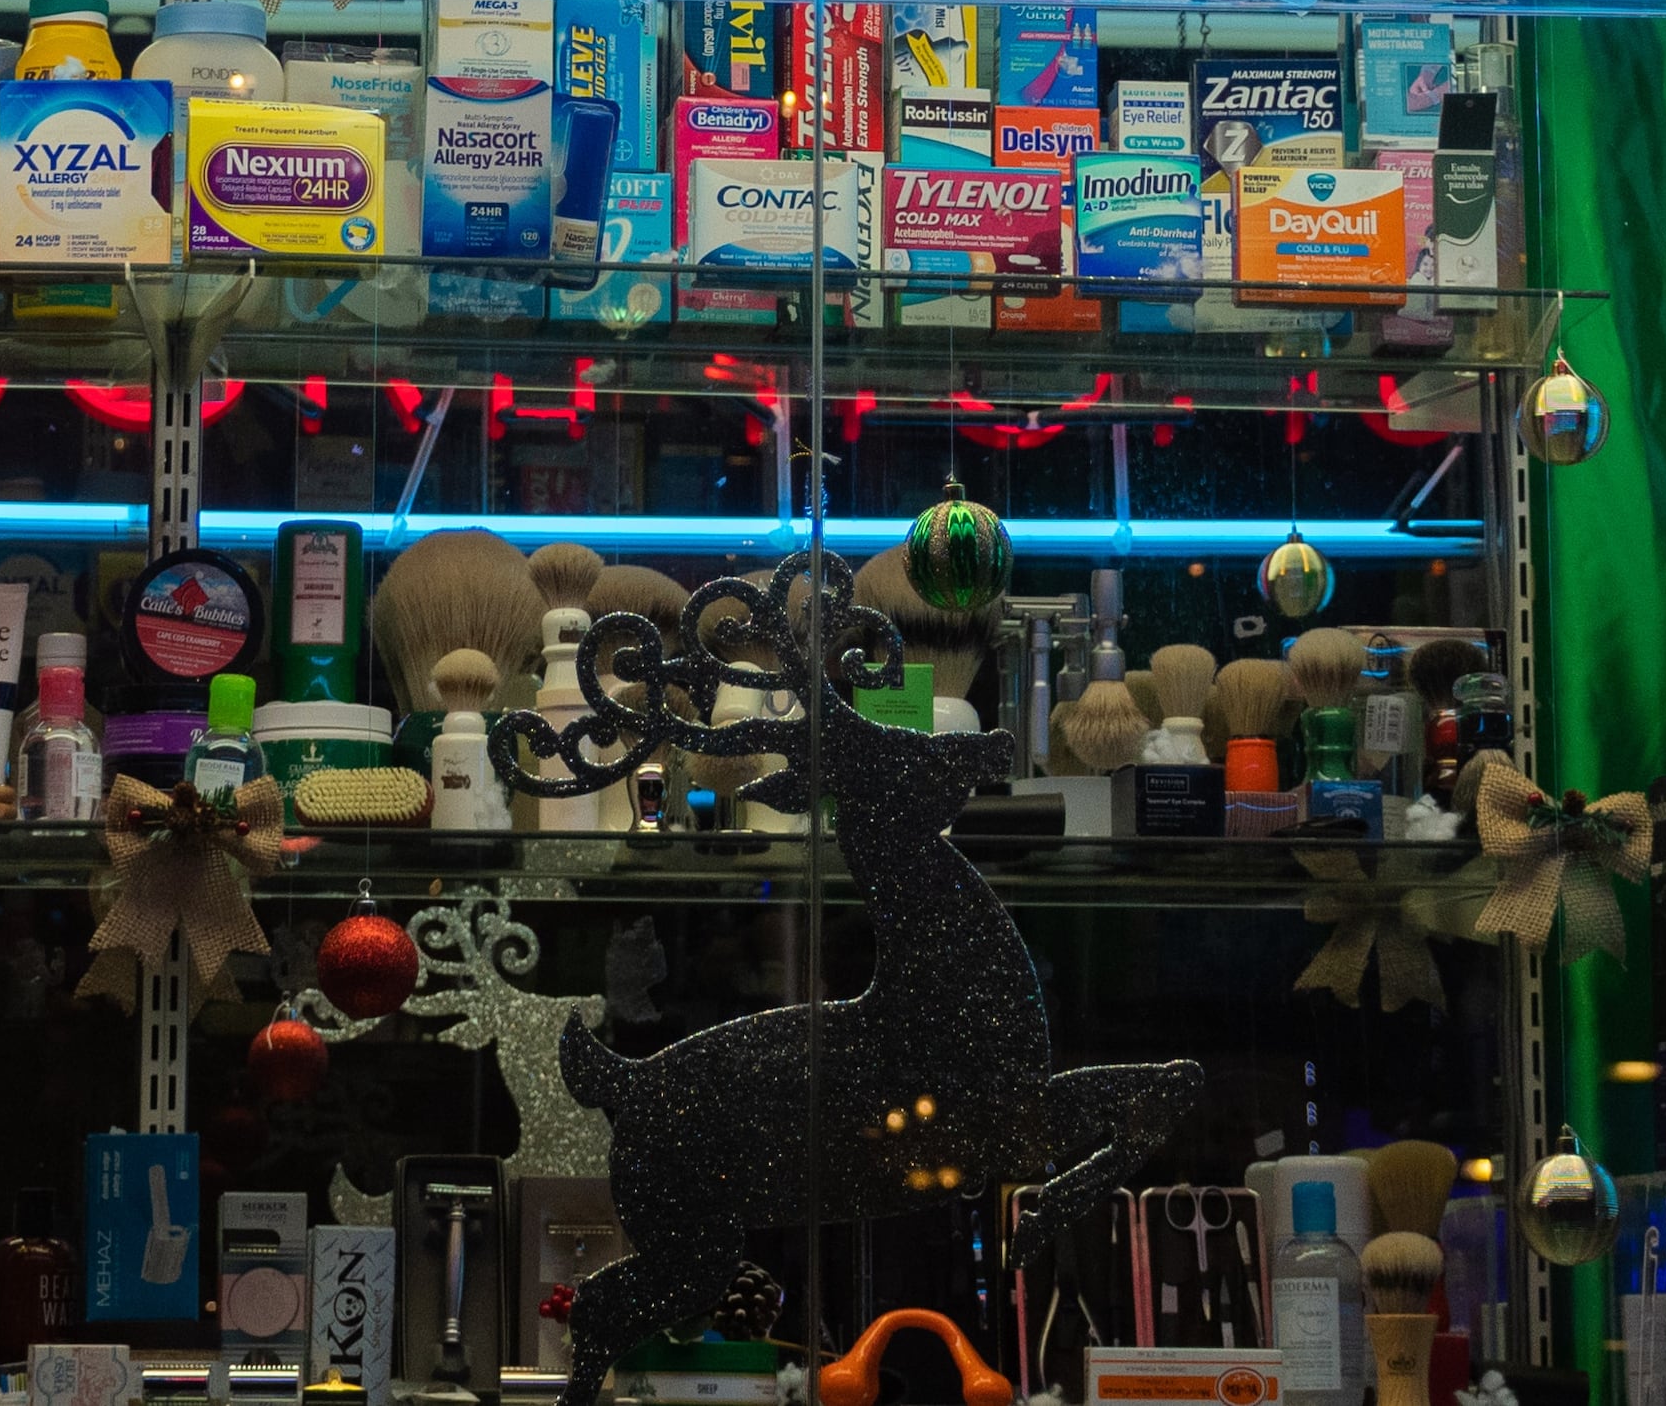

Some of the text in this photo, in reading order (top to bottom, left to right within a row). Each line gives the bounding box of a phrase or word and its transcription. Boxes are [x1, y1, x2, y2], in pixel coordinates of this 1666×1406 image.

[474, 0, 519, 10] MEGA-3
[1026, 12, 1066, 21] ULTRA
[1367, 28, 1435, 40] MOTION-RELIEF
[1367, 40, 1425, 51] WRISTBANDS
[1232, 69, 1338, 80] MAXIMUM STRENGTH
[331, 76, 413, 93] NoseFrida
[855, 46, 869, 147] Extra Strength
[1202, 77, 1338, 110] Zantac
[711, 105, 750, 114] Children's
[1124, 101, 1185, 109] ADVANCED
[904, 106, 988, 122] Robitussin
[1122, 110, 1183, 126] Eye Relief
[1302, 110, 1334, 129] 150
[697, 111, 763, 132] Benadryl
[235, 125, 338, 136] Treats Frequent Heartburn
[1052, 124, 1094, 134] Children's
[438, 128, 537, 149] Nasacort
[712, 135, 747, 144] ALLERGY
[1001, 126, 1094, 157] Delsym
[1129, 138, 1179, 148] Eye Wash
[13, 144, 141, 172] XYZAL
[226, 148, 347, 179] Nexium
[433, 150, 543, 170] Allergy 24HR
[1450, 163, 1481, 173] Esmalte
[27, 173, 89, 185] ALLERGY
[778, 171, 801, 179] DAY
[1243, 174, 1282, 184] POWERFUL
[1084, 168, 1193, 200] Imodium
[1243, 186, 1268, 194] RELIEF
[1309, 182, 1335, 191] VICKS
[893, 171, 1052, 211] TYLENOL
[717, 185, 838, 211] CONTAC
[470, 206, 503, 218] 24HR
[1083, 201, 1109, 212] A-D
[894, 212, 983, 227] COLD MAX
[1269, 208, 1379, 241] DayQuil
[192, 226, 207, 235] 28
[894, 227, 954, 239] Acetaminophen
[1129, 226, 1198, 239] Anti-Diarrheal
[15, 234, 61, 247] 24 HOUR
[192, 235, 230, 243] CAPSULES
[1296, 244, 1320, 254] COLD
[1333, 245, 1350, 255] FLU
[193, 604, 247, 627] Bubbles
[94, 1227, 115, 1308] MEHAZ
